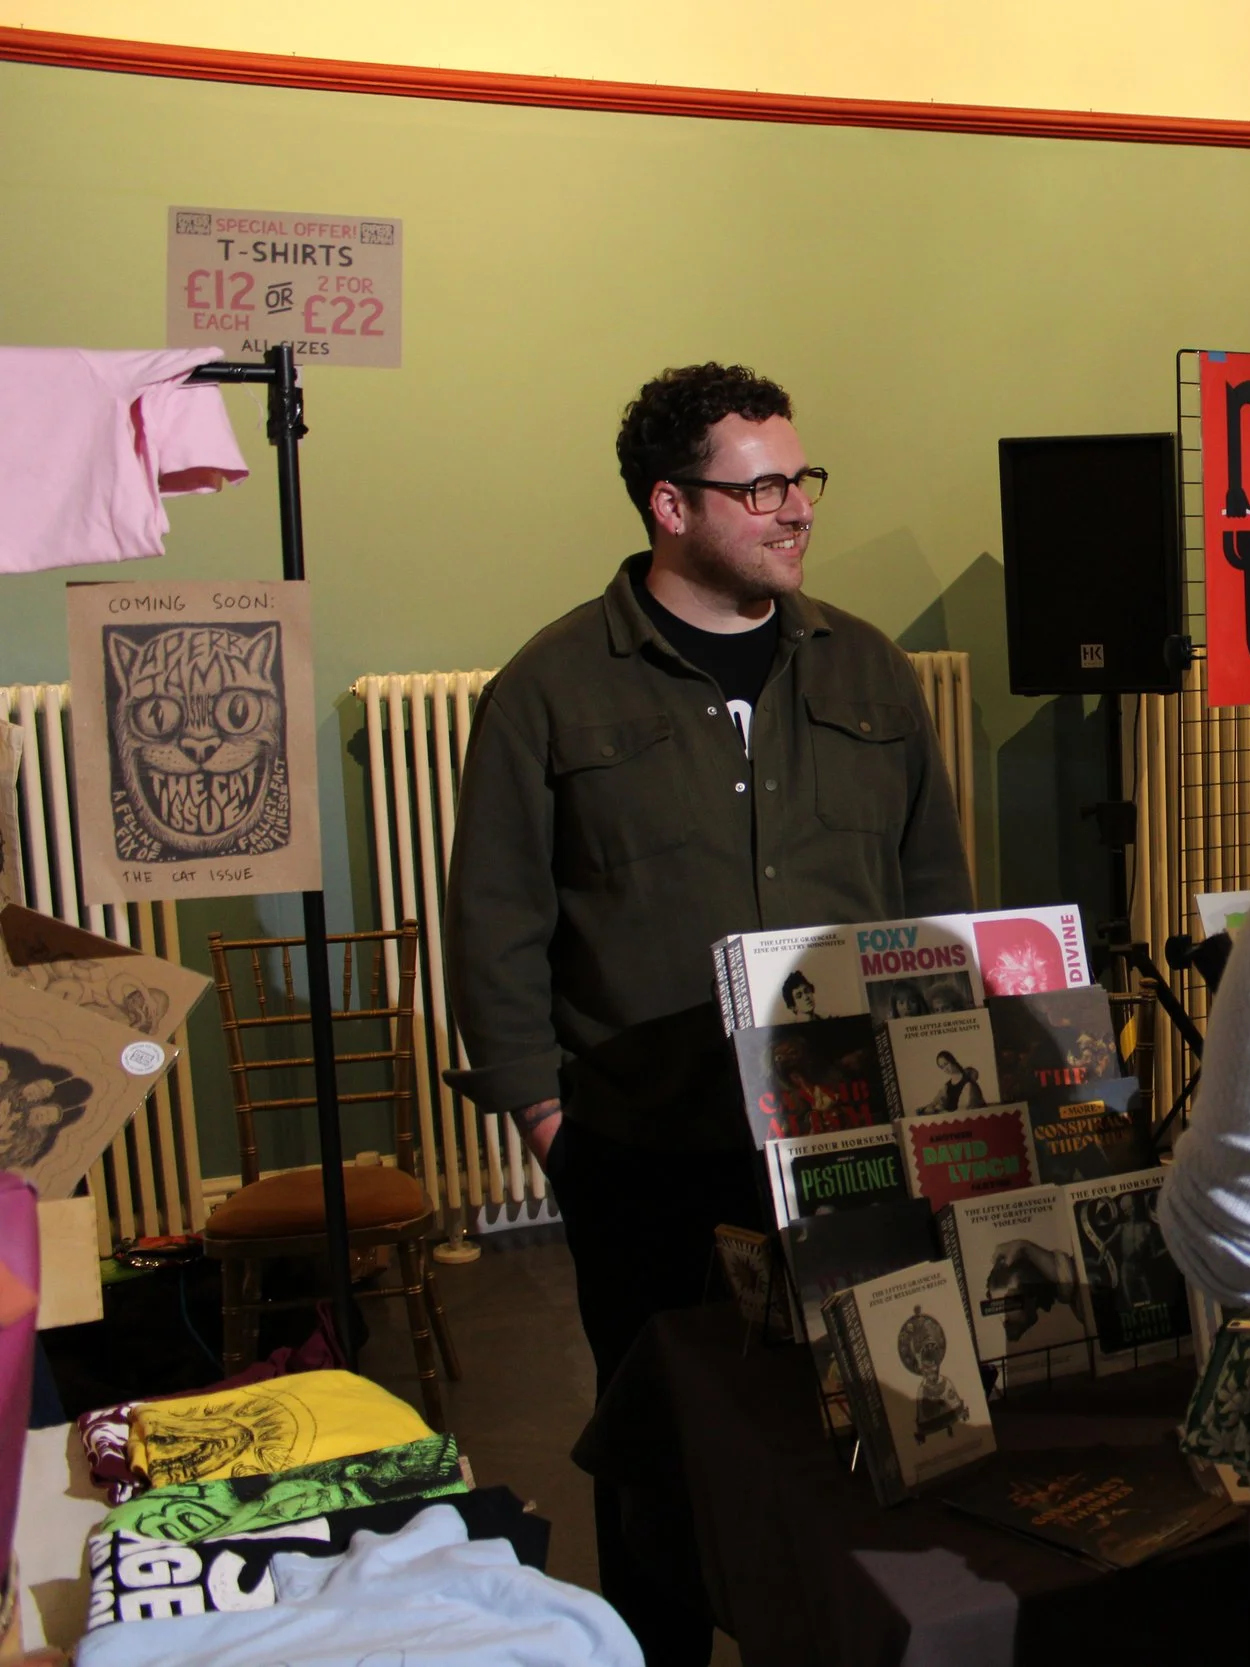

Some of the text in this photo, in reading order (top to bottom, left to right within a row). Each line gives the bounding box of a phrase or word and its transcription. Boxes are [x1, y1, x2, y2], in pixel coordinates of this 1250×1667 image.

[216, 218, 287, 237] SPECIAL
[294, 221, 358, 240] OFFER!
[217, 238, 354, 268] T-SHIRTS
[184, 268, 256, 311] £12
[318, 275, 373, 295] 2 FOR
[265, 286, 293, 310] OR
[193, 312, 250, 331] EACH
[302, 294, 385, 337] £22
[241, 339, 270, 353] ALL
[109, 593, 275, 614] COMING SOON:
[149, 764, 257, 807] THE CAT
[160, 788, 248, 835] ISSUE
[115, 803, 164, 858] FELINE
[123, 867, 254, 883] THE CAT ISSUE
[775, 937, 798, 945] LITTLE
[800, 933, 839, 942] GRAYSCALE
[780, 944, 806, 952] SULTRY
[857, 926, 918, 953] FOXY
[1060, 913, 1084, 984] DIVINE
[860, 944, 967, 976] MORONS
[904, 1032, 920, 1040] ZINE
[920, 1030, 929, 1038] OF
[905, 1025, 918, 1033] THE
[919, 1023, 942, 1031] LITTLE
[1034, 1066, 1089, 1088] THE
[1068, 1103, 1097, 1115] MORE
[788, 1145, 808, 1156] THE
[811, 1141, 838, 1153] FOUR
[922, 1140, 988, 1166] DAVID
[800, 1155, 898, 1202] PESTILENCE
[948, 1155, 1020, 1183] LYNCH
[1070, 1188, 1089, 1200] THE
[1091, 1185, 1117, 1196] FOUR
[965, 1196, 1057, 1217] THE LITTLE GRAYSCALE
[970, 1215, 989, 1224] ZINE
[993, 1216, 1032, 1228] VIOLENCE
